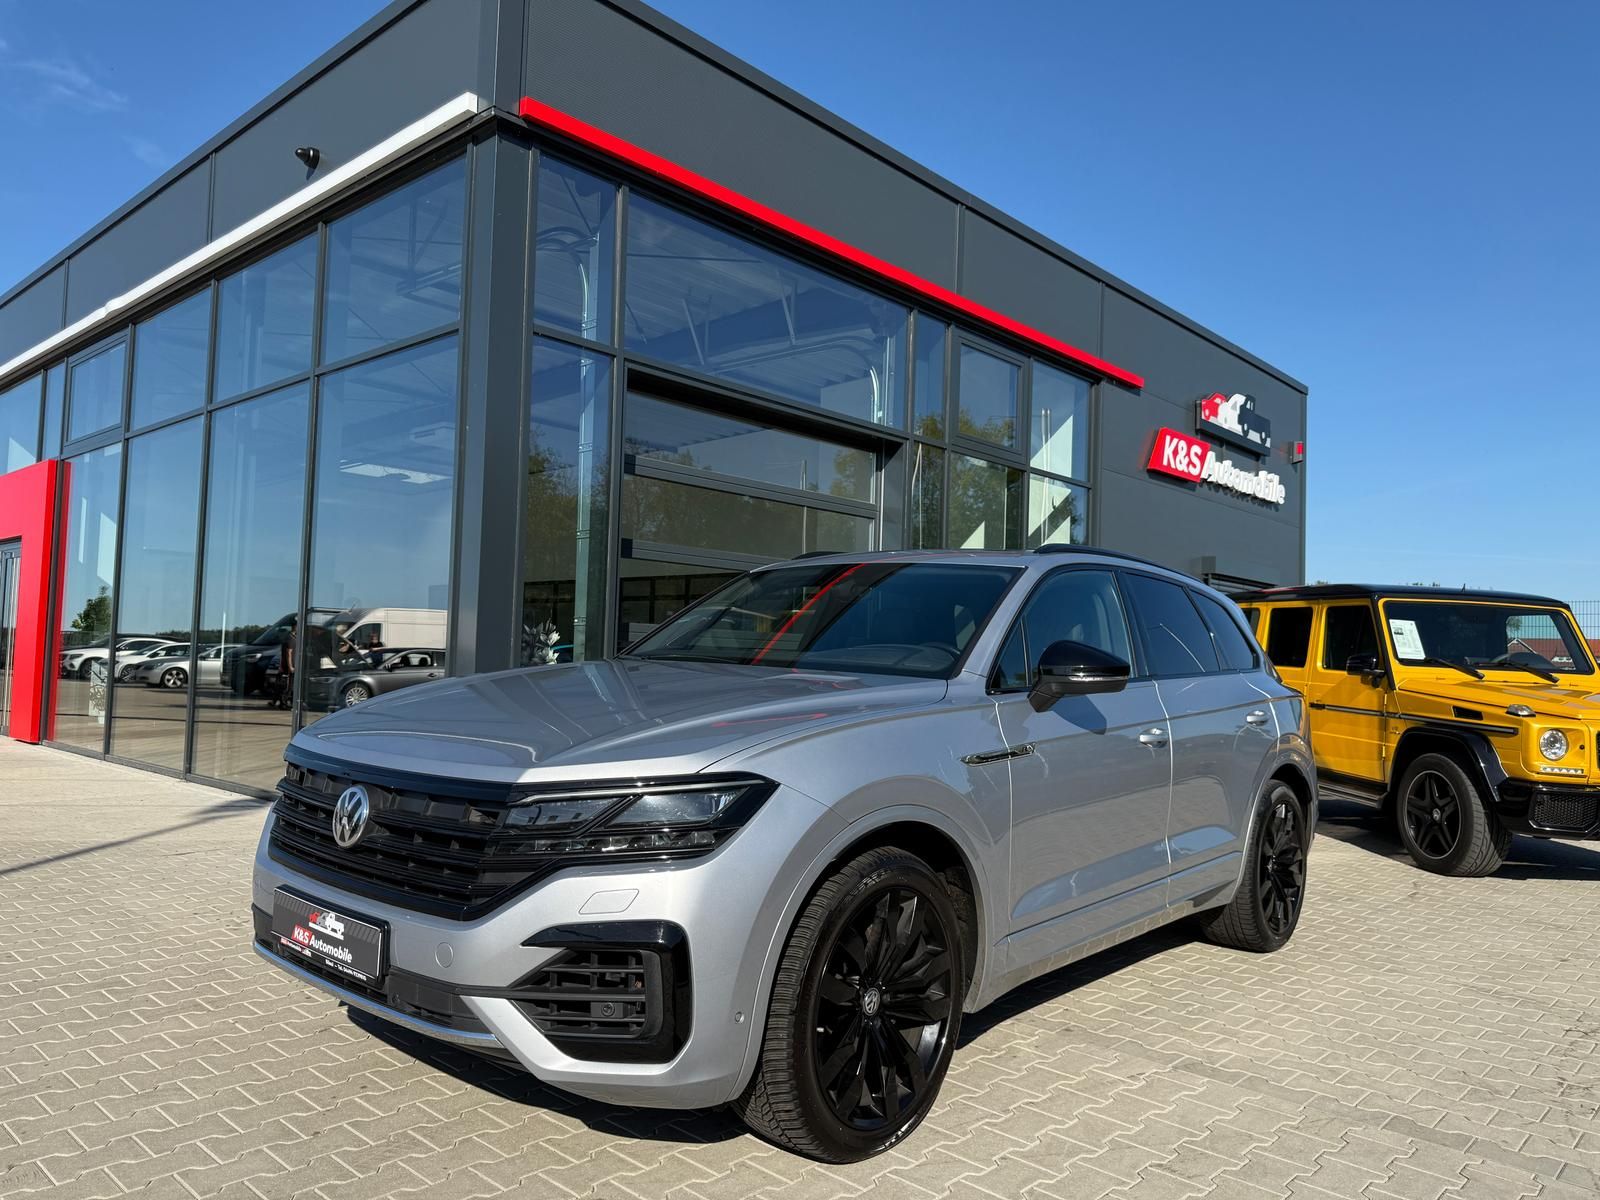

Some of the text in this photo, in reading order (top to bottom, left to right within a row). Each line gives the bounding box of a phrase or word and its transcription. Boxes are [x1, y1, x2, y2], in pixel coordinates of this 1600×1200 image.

[1163, 434, 1286, 505] K&S Automobile
[294, 926, 310, 944] K&S
[309, 934, 353, 963] Automobile
